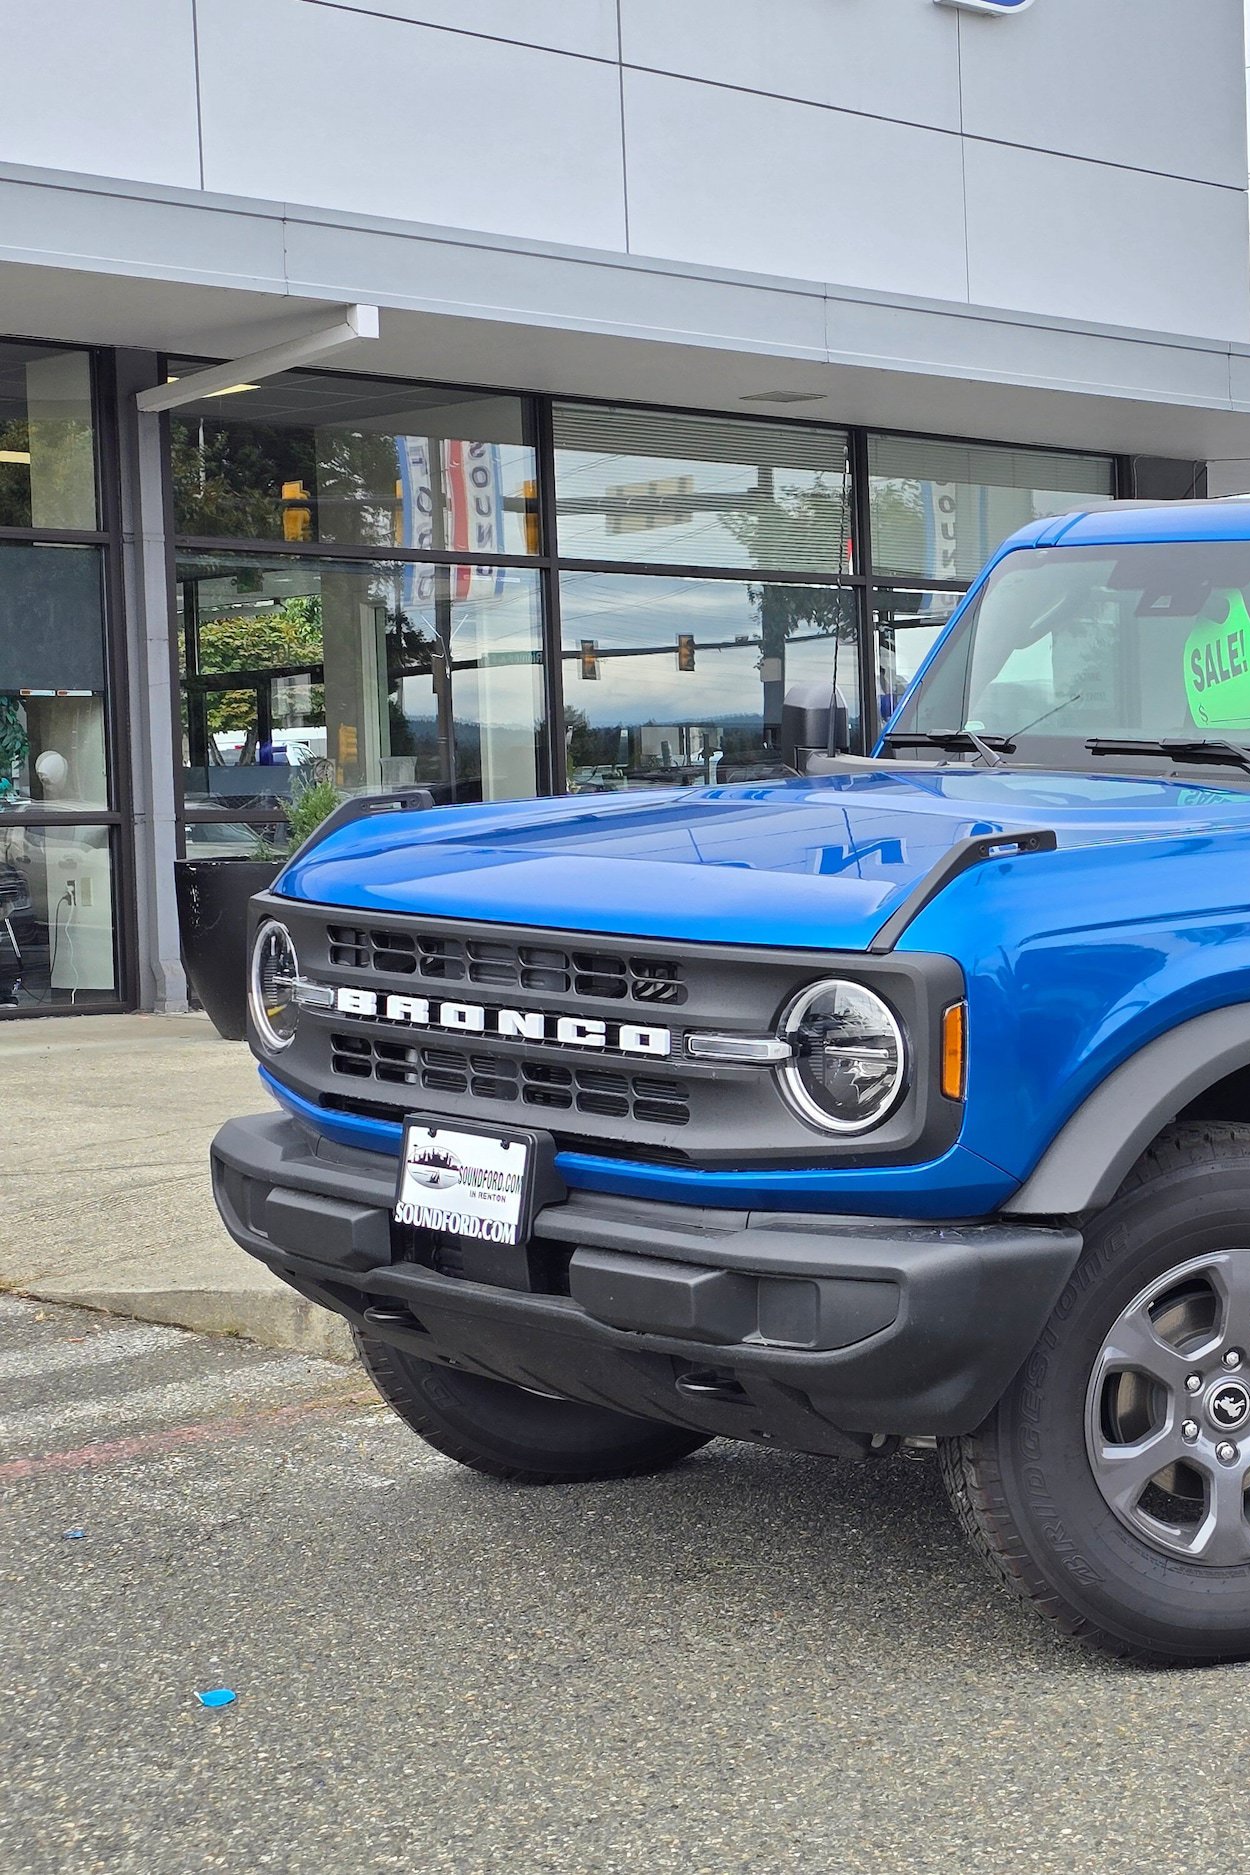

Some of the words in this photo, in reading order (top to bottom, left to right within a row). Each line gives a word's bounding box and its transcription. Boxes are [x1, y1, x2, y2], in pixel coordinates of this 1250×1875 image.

[1191, 629, 1249, 692] SALE!
[337, 987, 671, 1057] BRONCO
[458, 1165, 523, 1194] SOUNDFORD.COM
[469, 1190, 477, 1199] IN
[478, 1191, 507, 1203] RENTON
[394, 1200, 517, 1246] SOUNDFORD.COM
[1016, 1223, 1129, 1588] BRIDGESTONE
